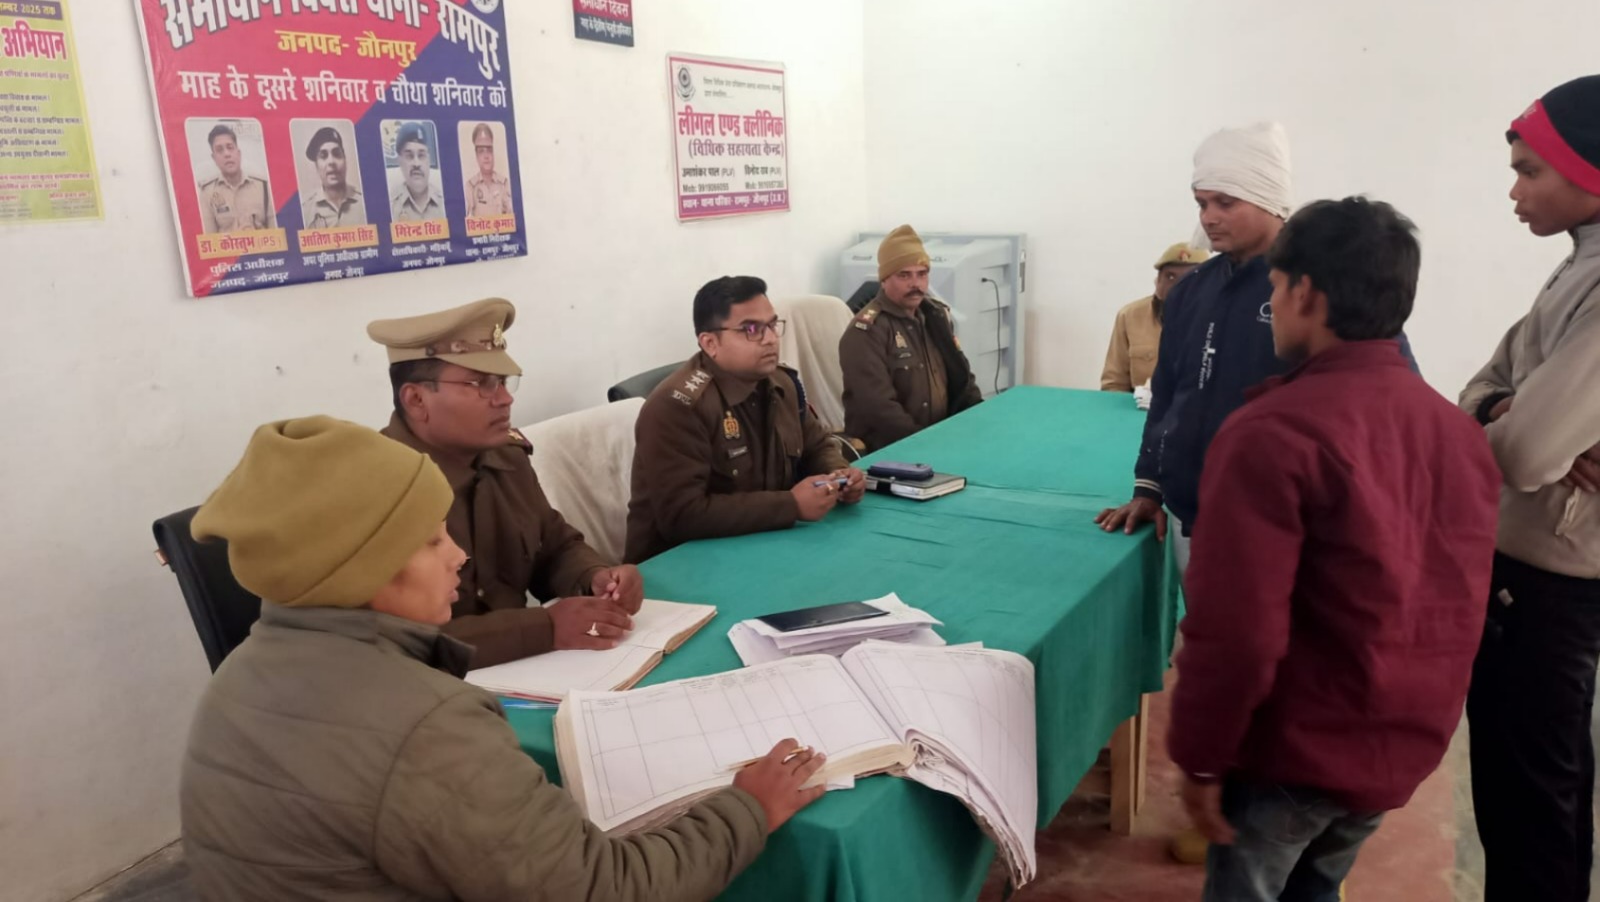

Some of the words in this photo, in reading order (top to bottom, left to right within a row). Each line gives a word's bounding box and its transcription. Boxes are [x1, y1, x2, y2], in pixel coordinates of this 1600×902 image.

[1, 20, 67, 60] अभियान
[355, 30, 417, 68] जौनपुर
[437, 0, 500, 80] रामपुर
[177, 71, 221, 98] माह
[226, 65, 249, 99] के
[254, 68, 298, 109] दूसरे
[302, 70, 369, 103] शनिवार
[373, 80, 387, 103] व
[390, 73, 427, 105] चौथा
[431, 77, 484, 107] शनिवार
[487, 81, 507, 108] को
[677, 105, 715, 136] लीगल
[718, 114, 741, 137] एण्ड
[743, 109, 783, 137] क्लीनिक
[727, 143, 762, 156] सहायता
[333, 230, 356, 248] कुमार
[210, 261, 242, 277] पुलिस
